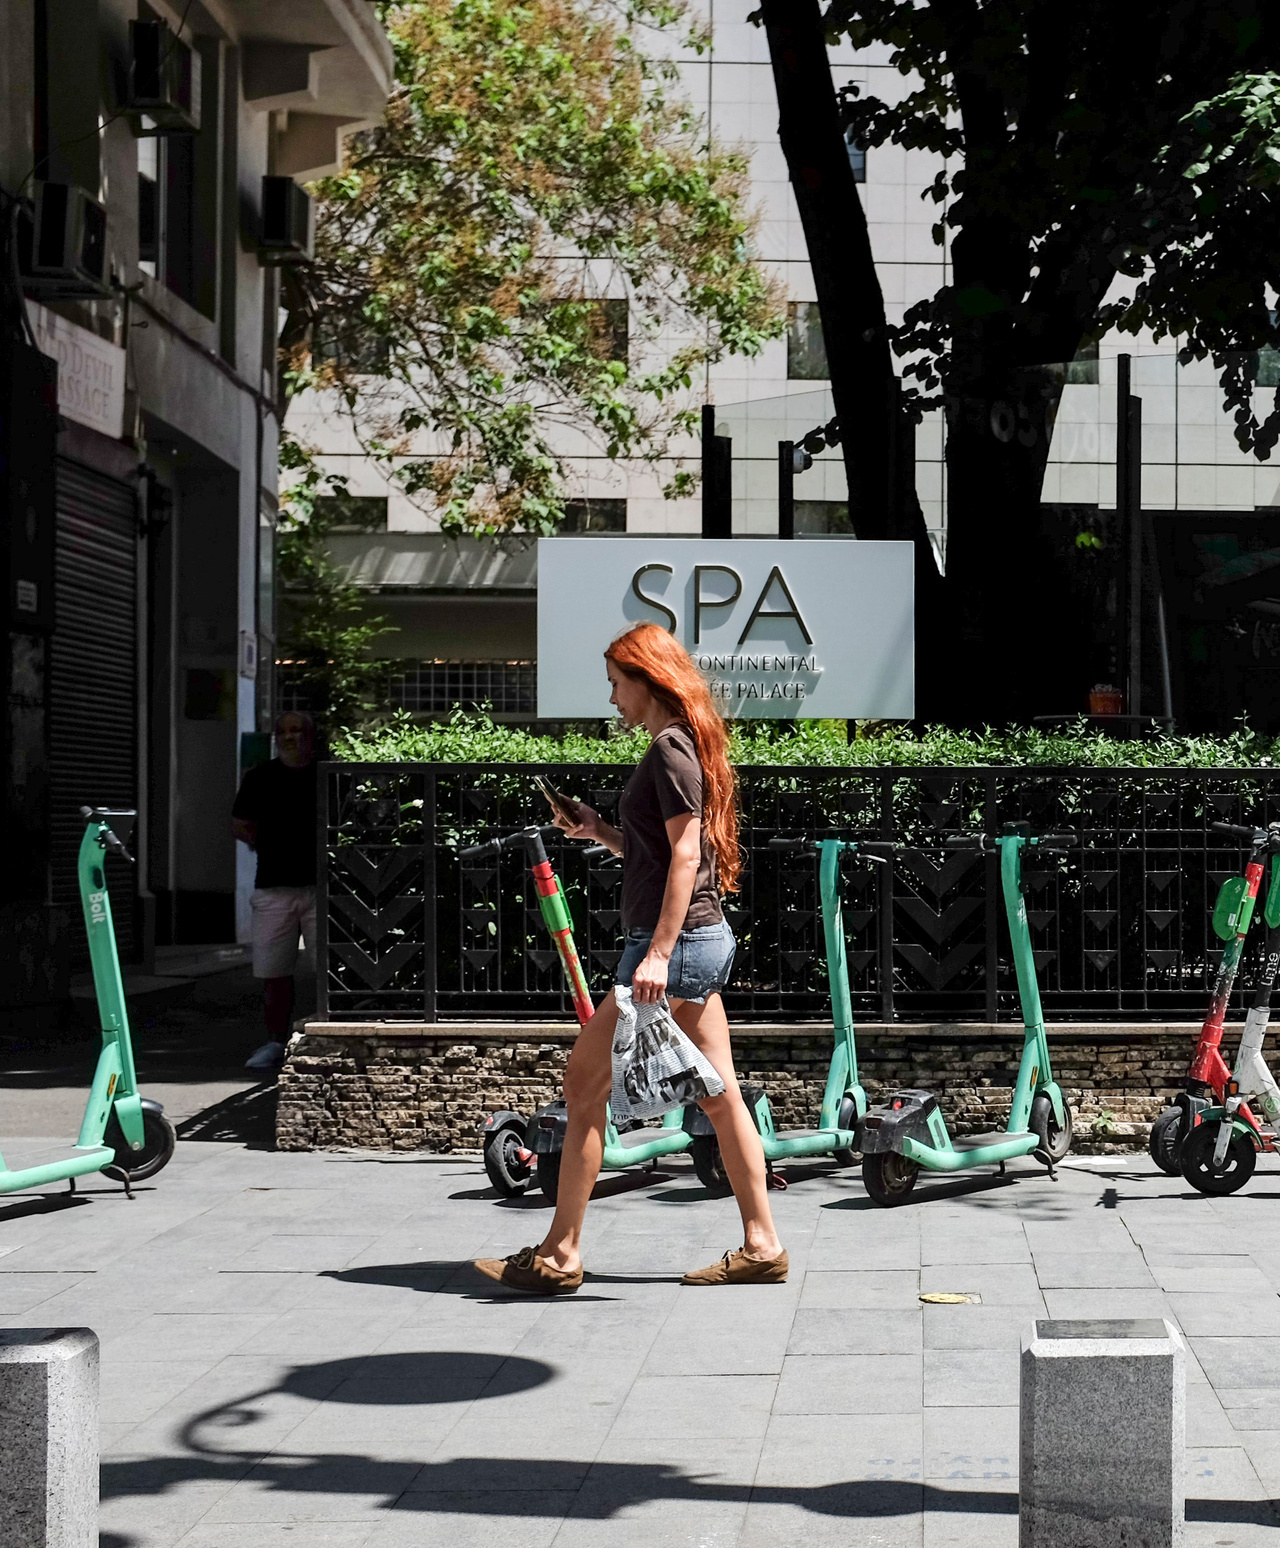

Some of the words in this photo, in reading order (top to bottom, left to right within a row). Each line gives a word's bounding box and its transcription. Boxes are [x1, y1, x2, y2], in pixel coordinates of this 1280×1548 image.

[72, 342, 113, 391] DEVIL
[59, 373, 109, 418] ASSAGE
[632, 563, 813, 645] SPA
[688, 654, 822, 671] CONTINENTAL
[738, 682, 805, 699] PALACE
[89, 892, 106, 924] Bolt
[1260, 952, 1279, 986] Lime
